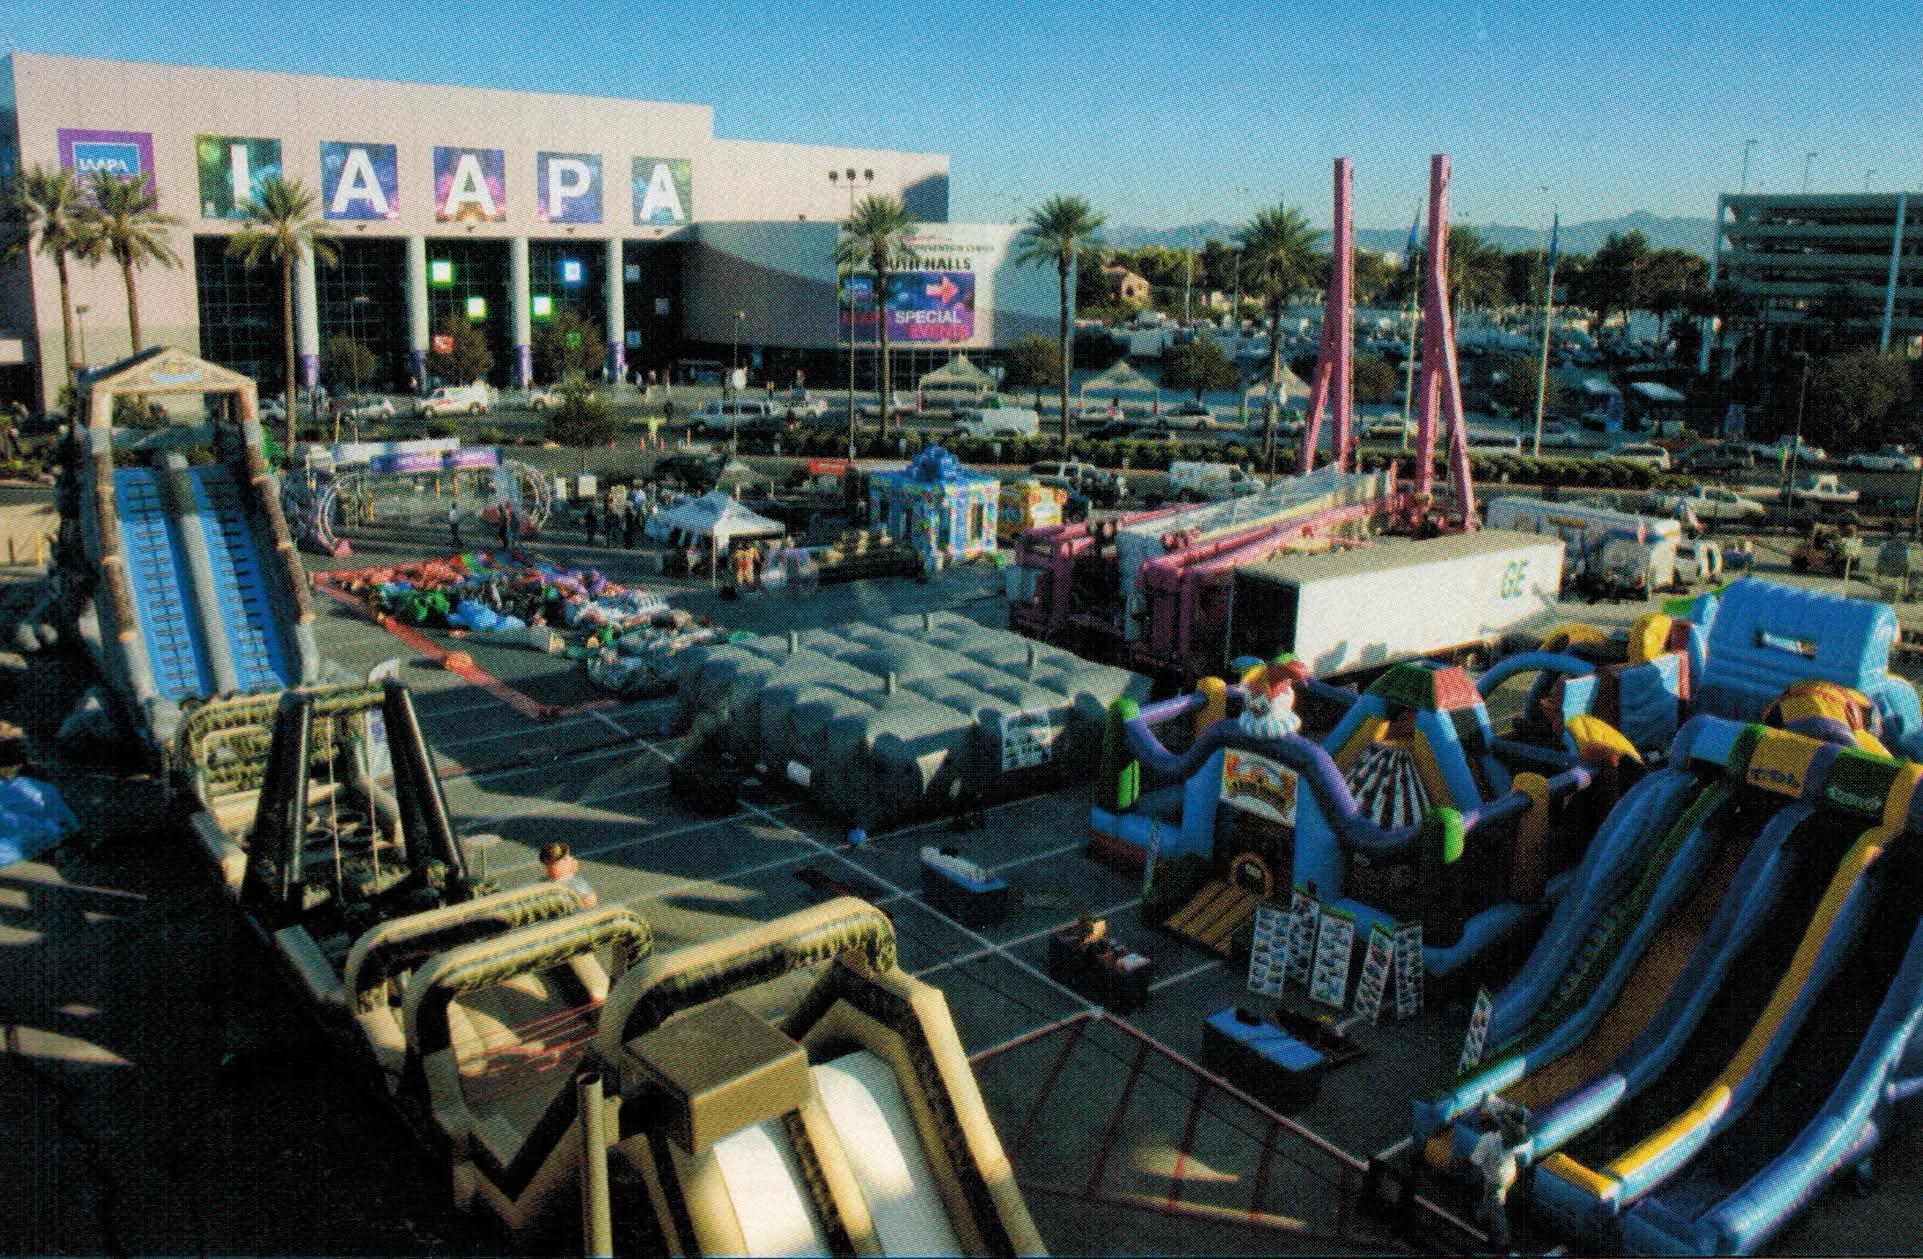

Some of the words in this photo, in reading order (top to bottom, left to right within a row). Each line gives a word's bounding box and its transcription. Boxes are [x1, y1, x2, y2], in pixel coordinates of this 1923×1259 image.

[231, 144, 685, 222] IAAPA
[924, 257, 971, 271] HALLS
[895, 310, 961, 324] SPECIAL
